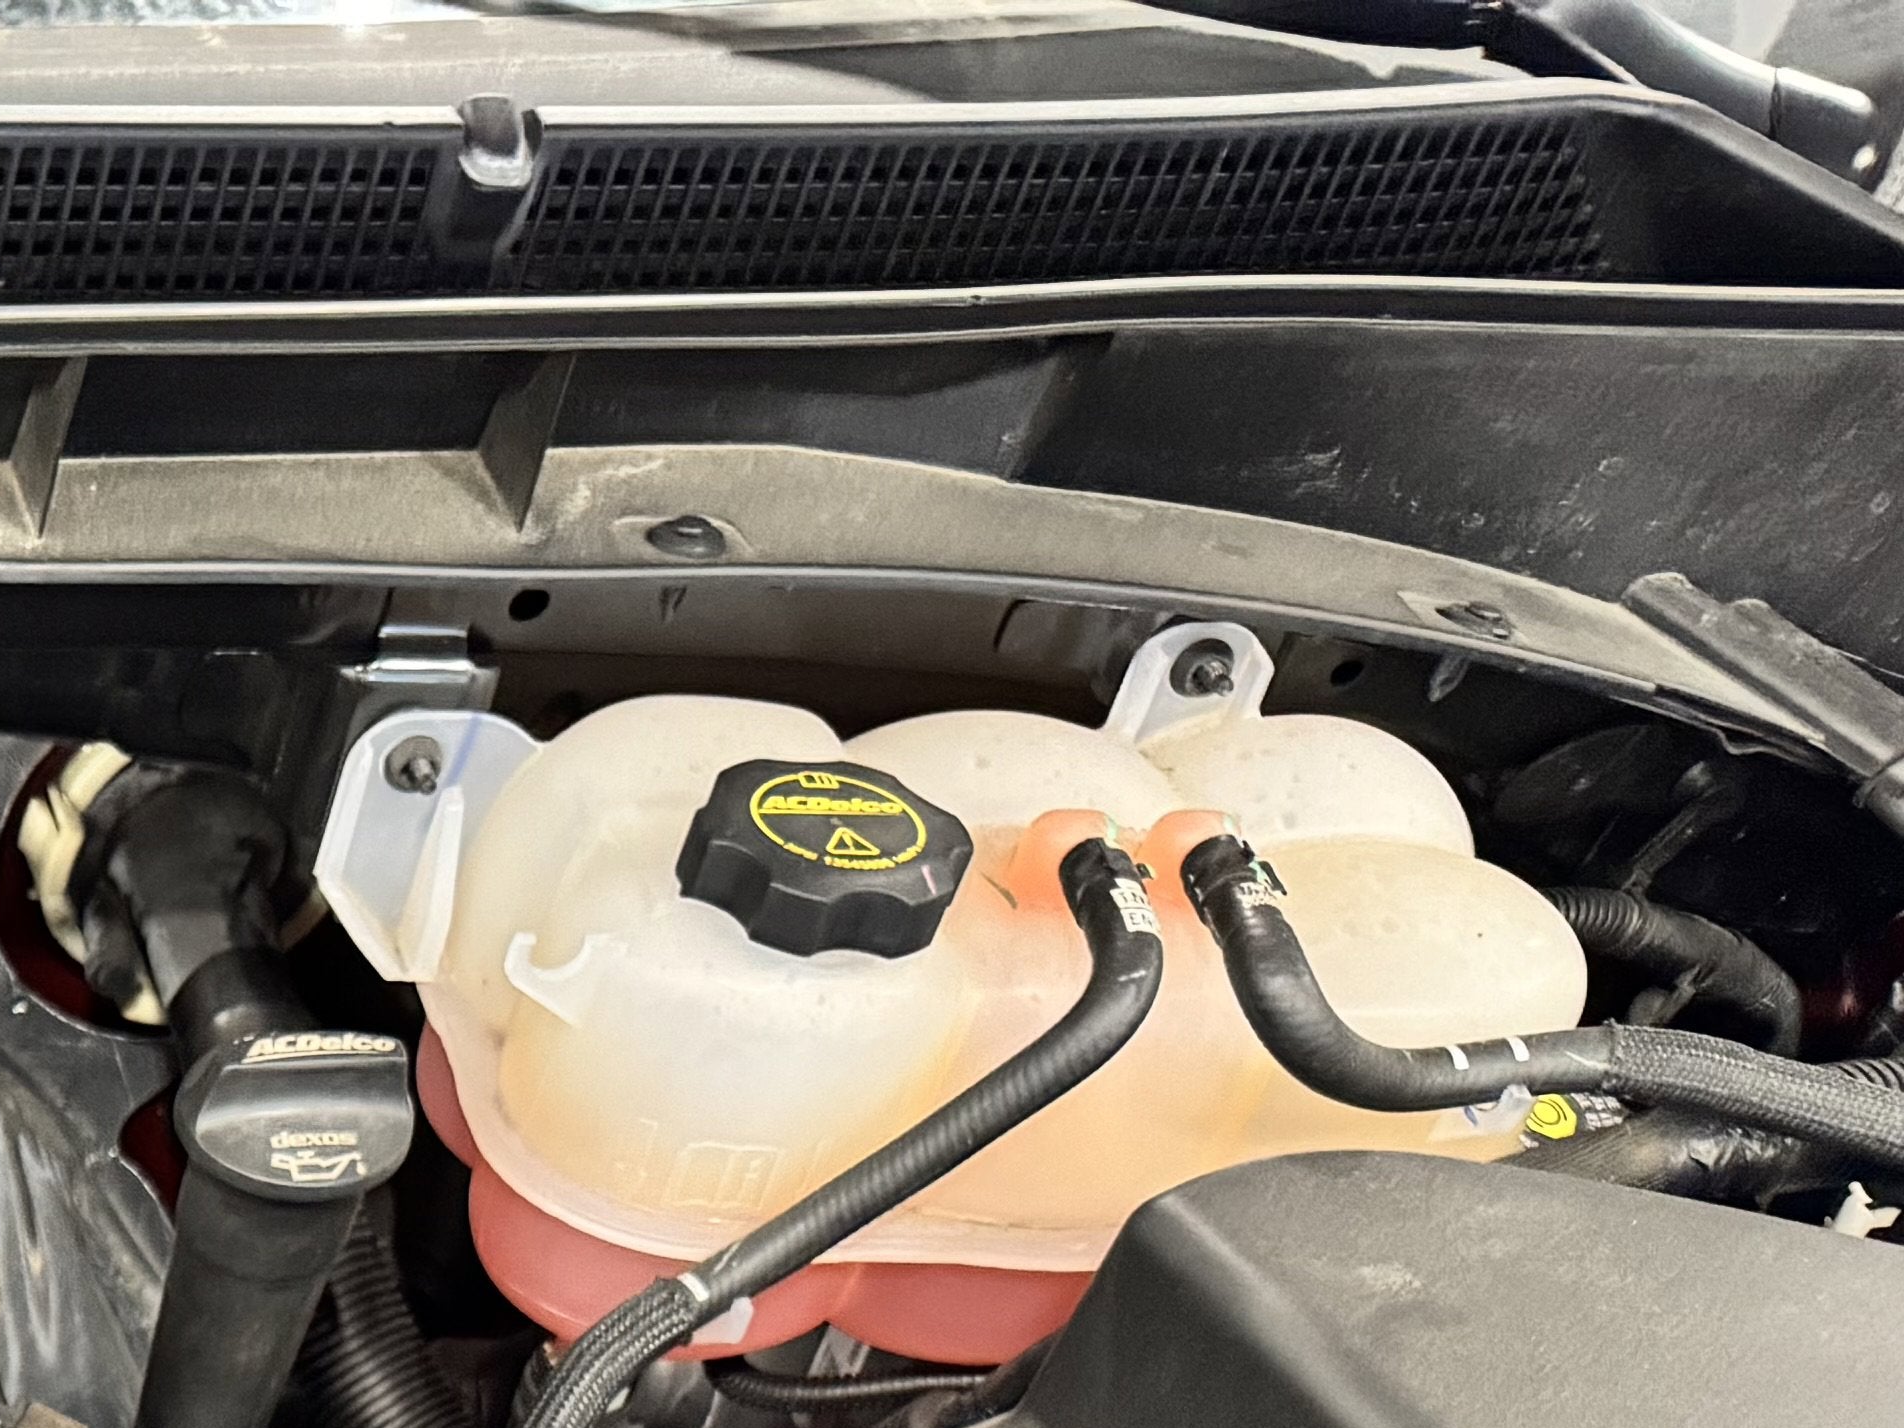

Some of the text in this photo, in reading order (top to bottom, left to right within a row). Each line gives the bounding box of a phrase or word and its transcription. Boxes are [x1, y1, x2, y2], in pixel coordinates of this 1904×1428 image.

[762, 795, 903, 814] ACDelco
[247, 1034, 395, 1058] ACDelco
[270, 1131, 358, 1149] dexos
